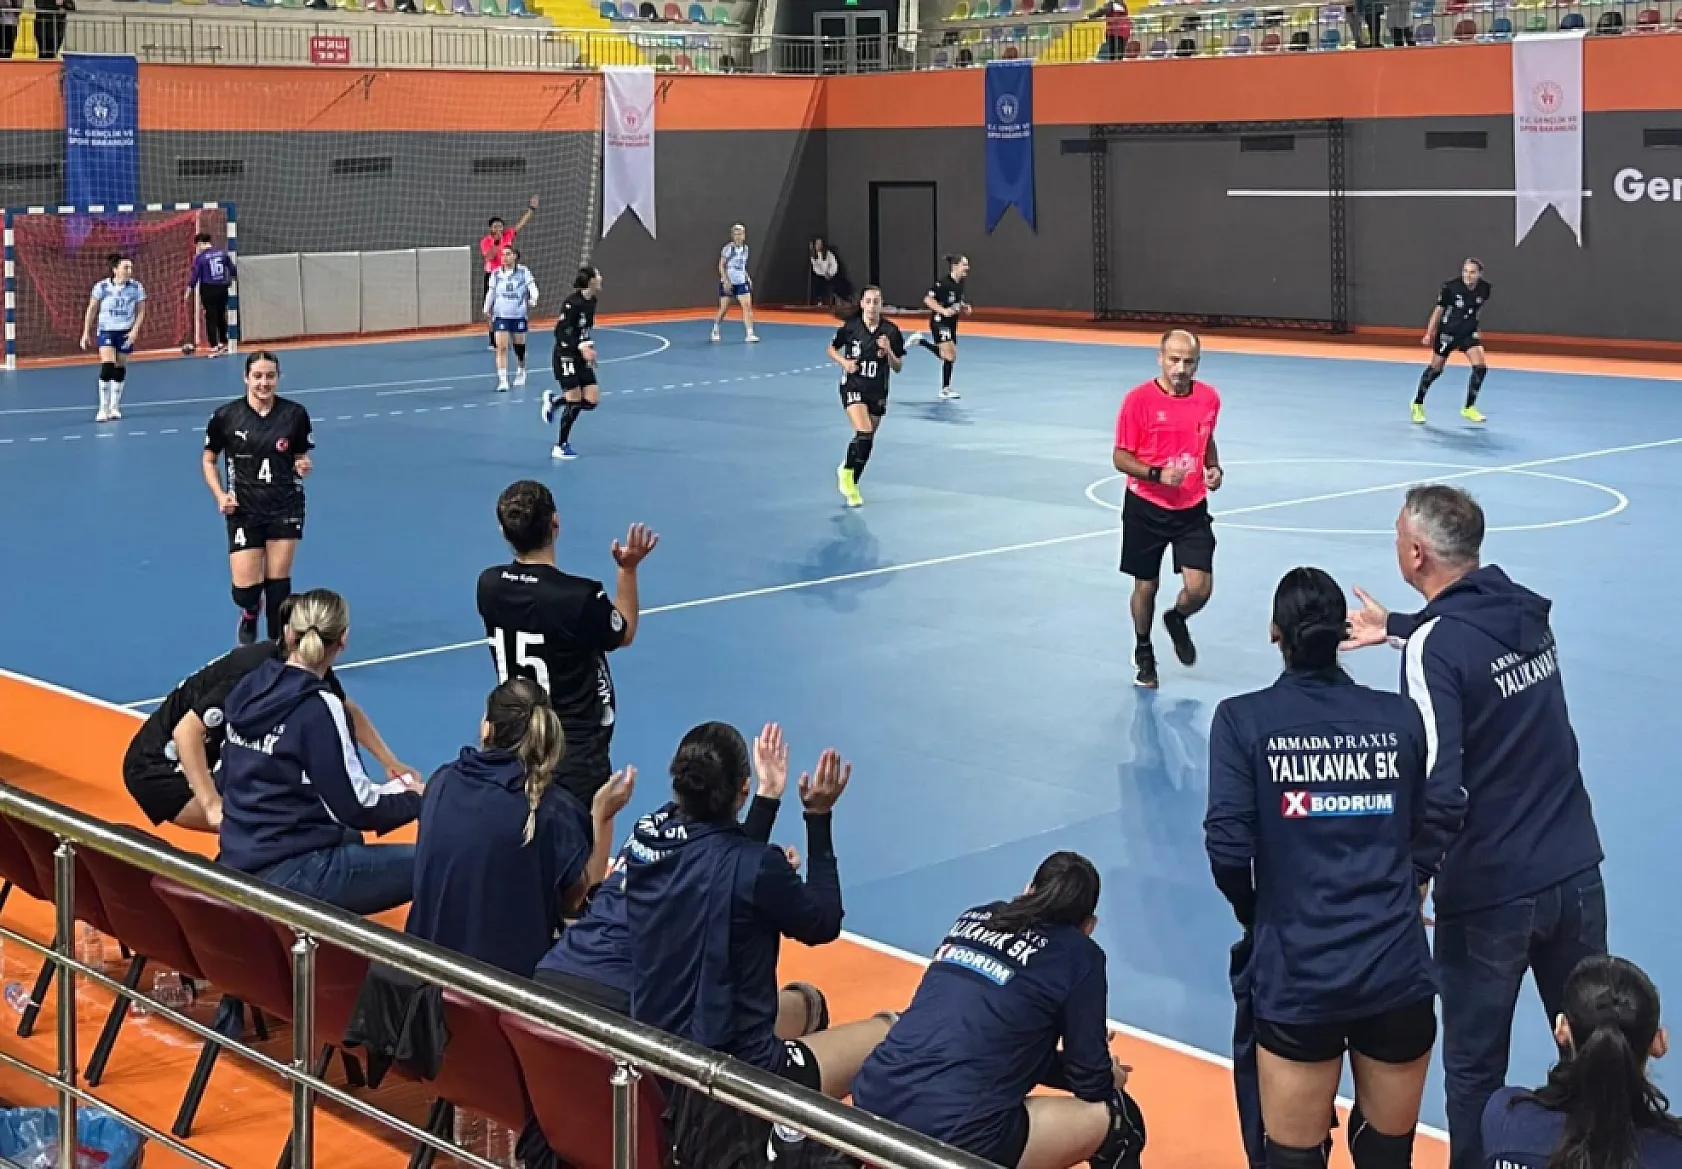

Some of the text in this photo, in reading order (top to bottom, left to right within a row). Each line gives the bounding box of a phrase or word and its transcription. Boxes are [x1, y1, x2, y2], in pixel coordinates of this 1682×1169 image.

[562, 361, 576, 376] 14
[860, 360, 877, 378] 10
[257, 458, 273, 484] 4
[234, 527, 248, 547] 4
[489, 626, 551, 696] 15
[1266, 732, 1398, 751] ARMADA PRAXIS
[1267, 750, 1400, 783] YALIKAVAK SK
[1311, 793, 1392, 812] BODRUM
[1006, 939, 1039, 967] SK
